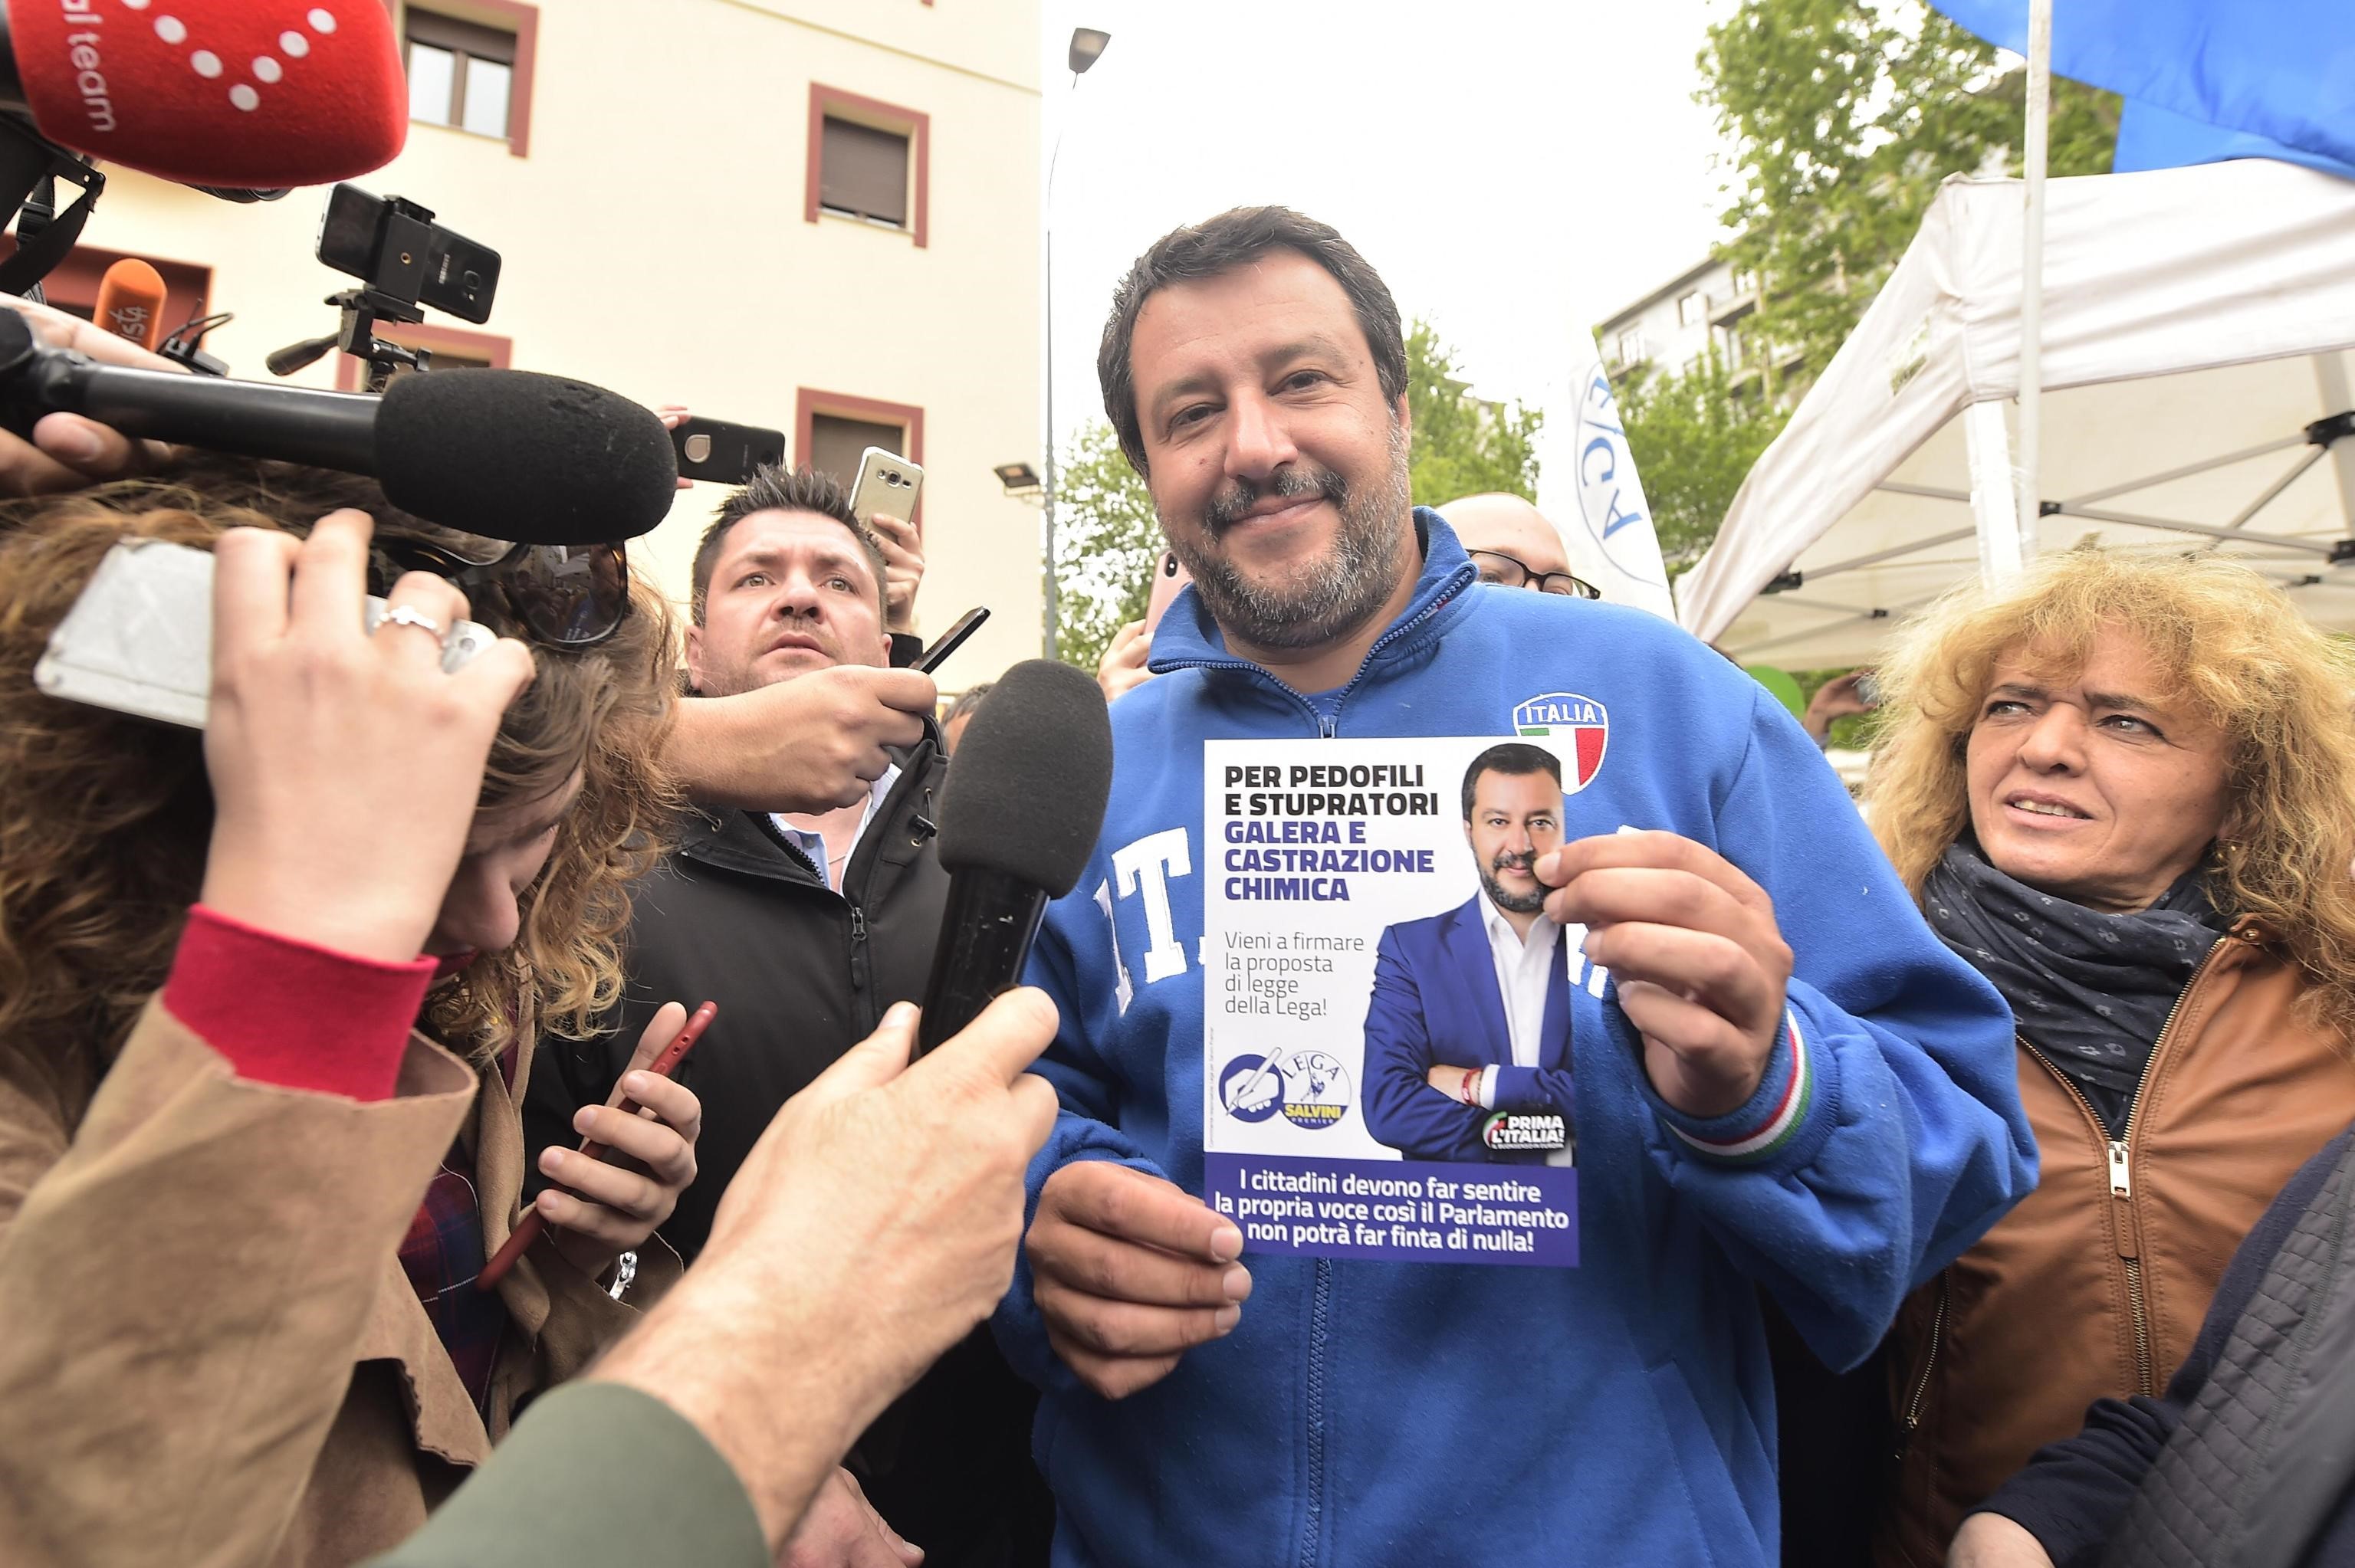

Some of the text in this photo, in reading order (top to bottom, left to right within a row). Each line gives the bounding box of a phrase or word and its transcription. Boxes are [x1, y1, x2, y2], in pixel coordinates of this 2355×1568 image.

[67, 32, 117, 133] team
[1524, 703, 1598, 723] ITALIA
[1225, 764, 1424, 788] PER PEDOFILI
[1225, 792, 1438, 816] E STUPRATORI
[1225, 821, 1366, 844] GALERA E
[1225, 848, 1434, 873] CASTRAZIONE
[1225, 877, 1350, 901] CHIMICA
[1225, 931, 1365, 951] Vieni a firmare
[1226, 952, 1334, 976] la proposta
[1225, 973, 1299, 999] di legge
[1225, 995, 1327, 1021] della Lega!
[1281, 1054, 1339, 1081] LEGA
[1285, 1104, 1342, 1119] SALVINI
[1508, 1115, 1565, 1130] PRIMA
[1491, 1129, 1565, 1143] L'ITALIA!
[1240, 1168, 1542, 1203] I cittadini devono far sentire
[1214, 1191, 1570, 1229] la propria voce così il Parlamento
[1247, 1222, 1535, 1252] non potrà far finta di nulla!
